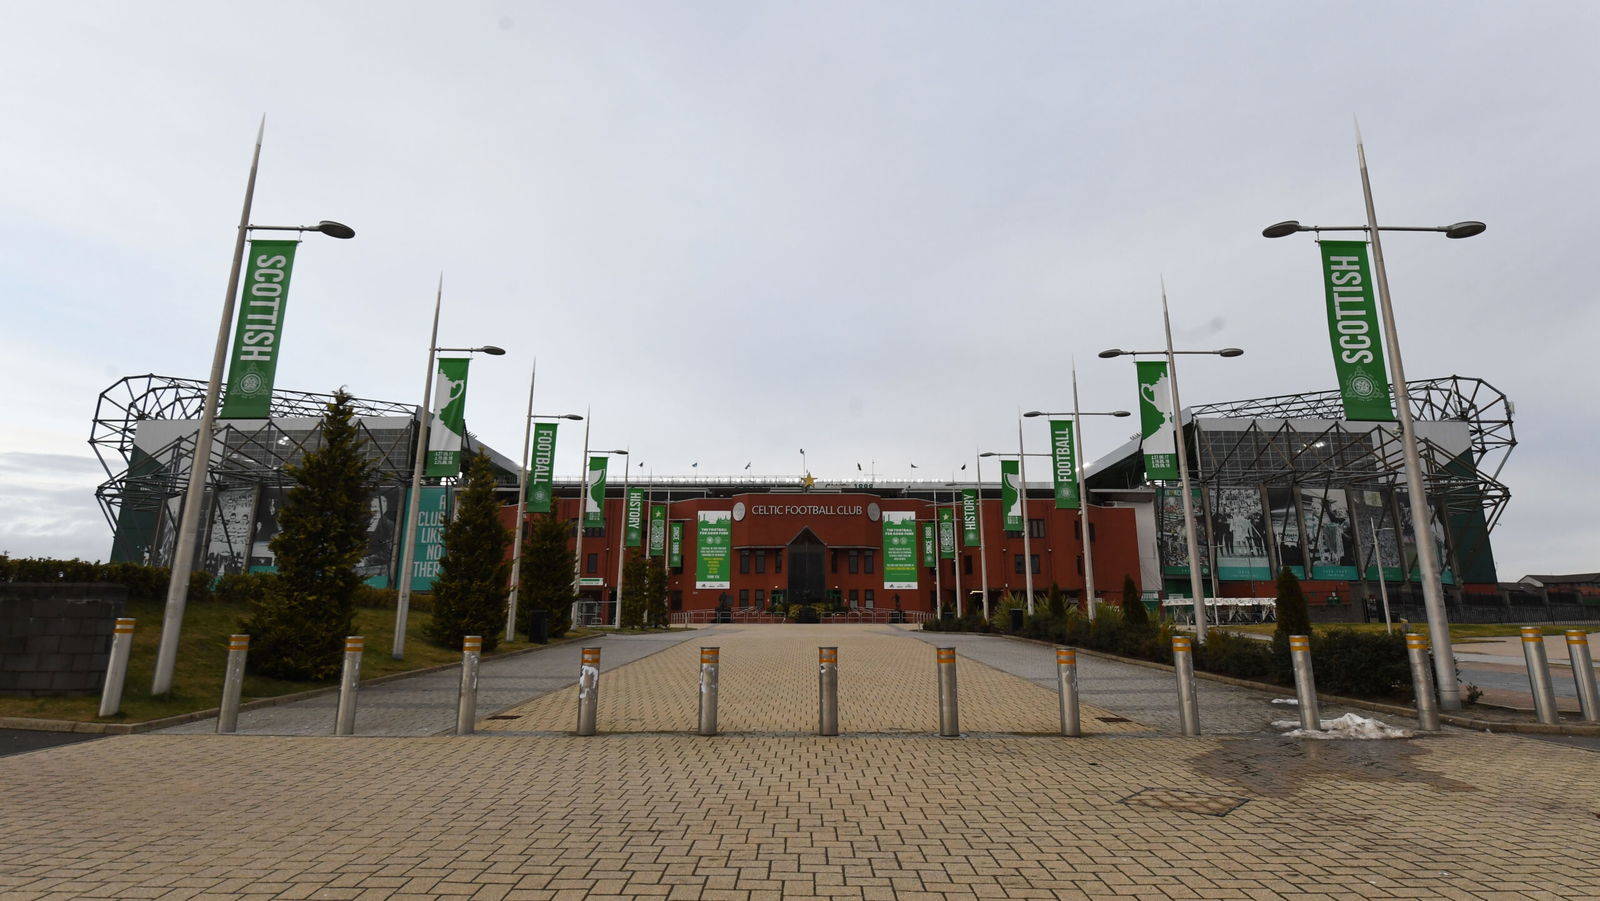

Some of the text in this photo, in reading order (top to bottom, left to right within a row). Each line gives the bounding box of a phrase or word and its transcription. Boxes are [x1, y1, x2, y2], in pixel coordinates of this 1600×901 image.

[240, 254, 287, 362] SCOTTISH
[1330, 255, 1374, 364] SCOTTISH
[533, 430, 553, 485] FOOTBALL
[1056, 428, 1072, 483] FOOTBALL
[439, 494, 446, 510] A
[628, 492, 641, 529] HISTORY
[752, 505, 862, 515] CELTIC FOOTBALL CLUB
[964, 494, 976, 530] HISTORY
[413, 561, 440, 577] THER
[426, 544, 442, 560] NO
